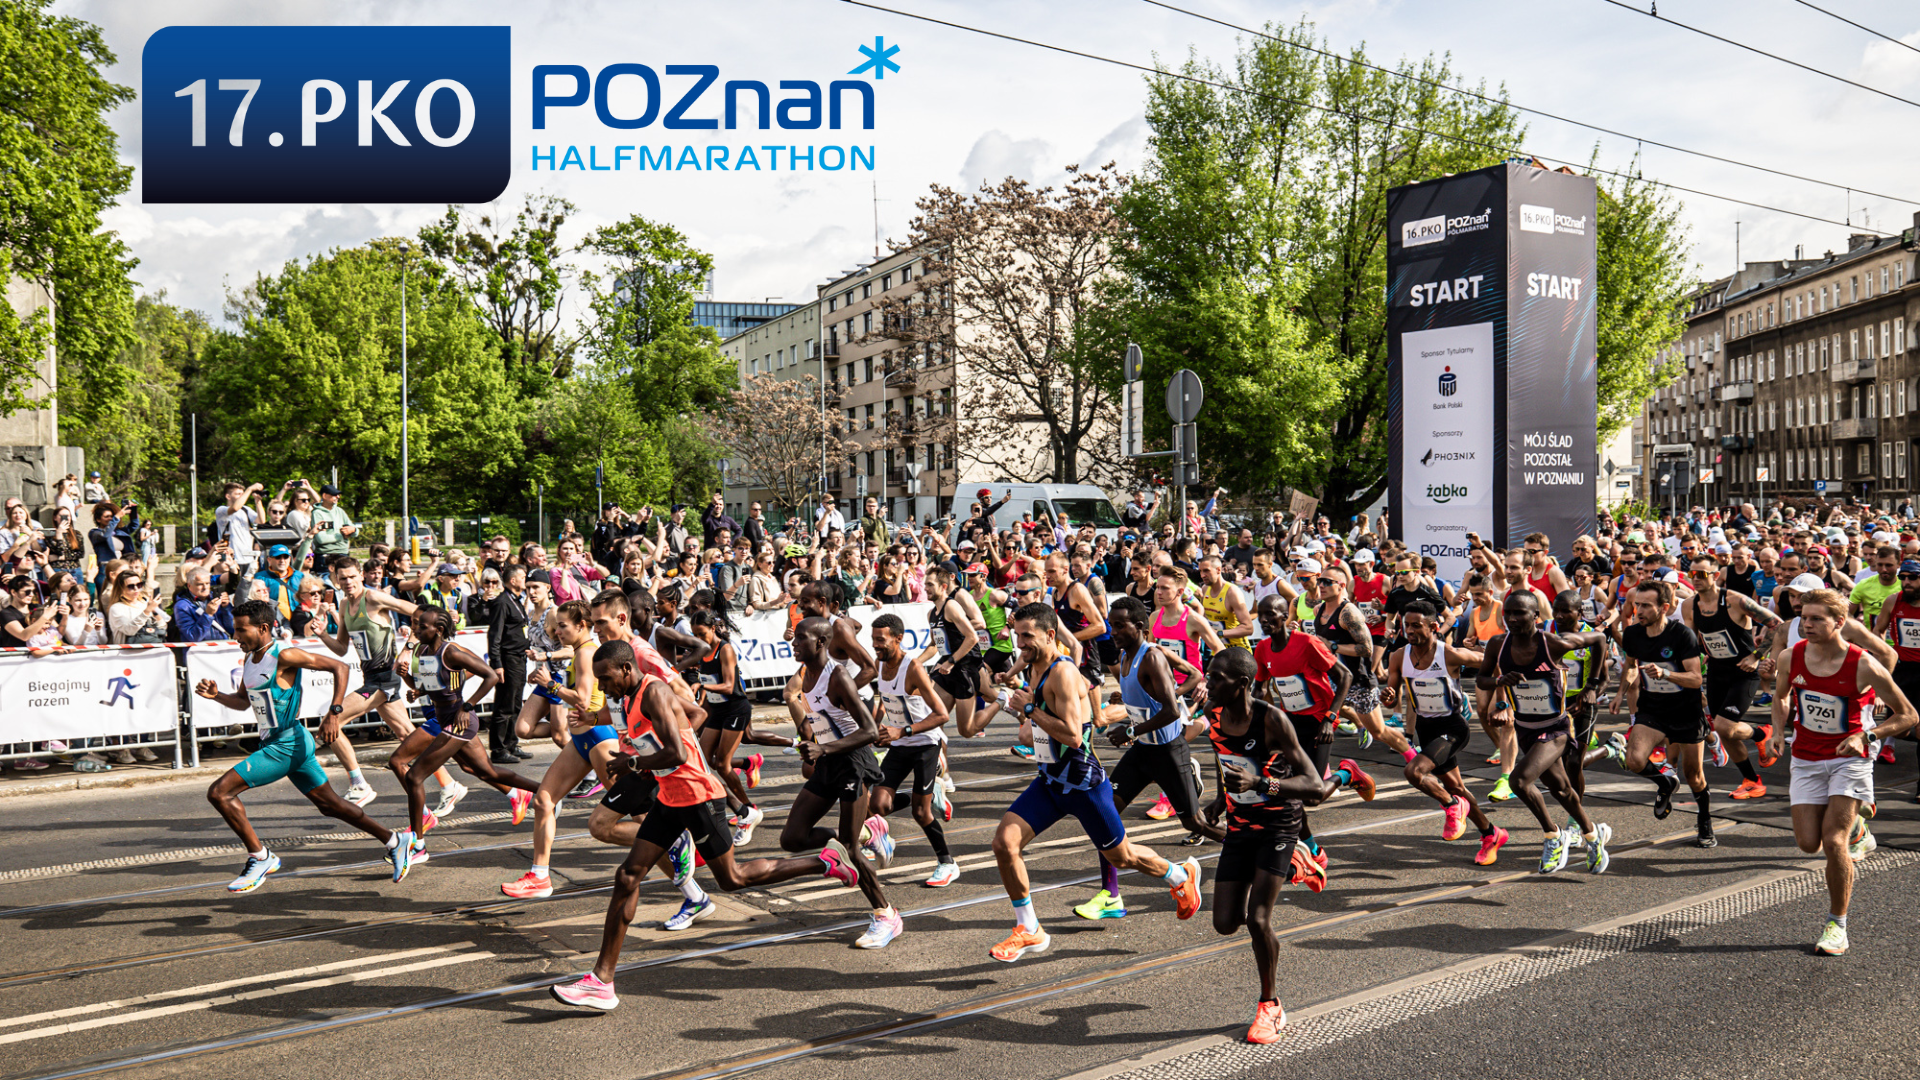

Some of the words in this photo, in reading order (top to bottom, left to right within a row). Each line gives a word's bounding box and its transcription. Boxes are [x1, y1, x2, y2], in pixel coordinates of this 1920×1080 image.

[1406, 223, 1442, 239] 16.PKO
[1410, 274, 1484, 307] START
[1526, 272, 1582, 301] START
[1421, 350, 1445, 358] Sponsor
[1447, 347, 1475, 356] Tytularny
[1447, 401, 1463, 409] Polski
[1432, 430, 1464, 438] Sponsorzy
[1523, 431, 1547, 448] MÓJ
[1548, 431, 1573, 448] ŚLAD
[1434, 452, 1476, 461] PHO3NIX
[1523, 452, 1573, 467] POZOSTAŁ
[1523, 471, 1536, 485] W
[1537, 471, 1584, 486] POZNANIU
[1426, 483, 1468, 498] żabka
[1425, 524, 1469, 533] Organizatorzy
[28, 679, 91, 694] Biegajmy
[28, 697, 70, 708] razem
[1806, 704, 1836, 719] 9761
